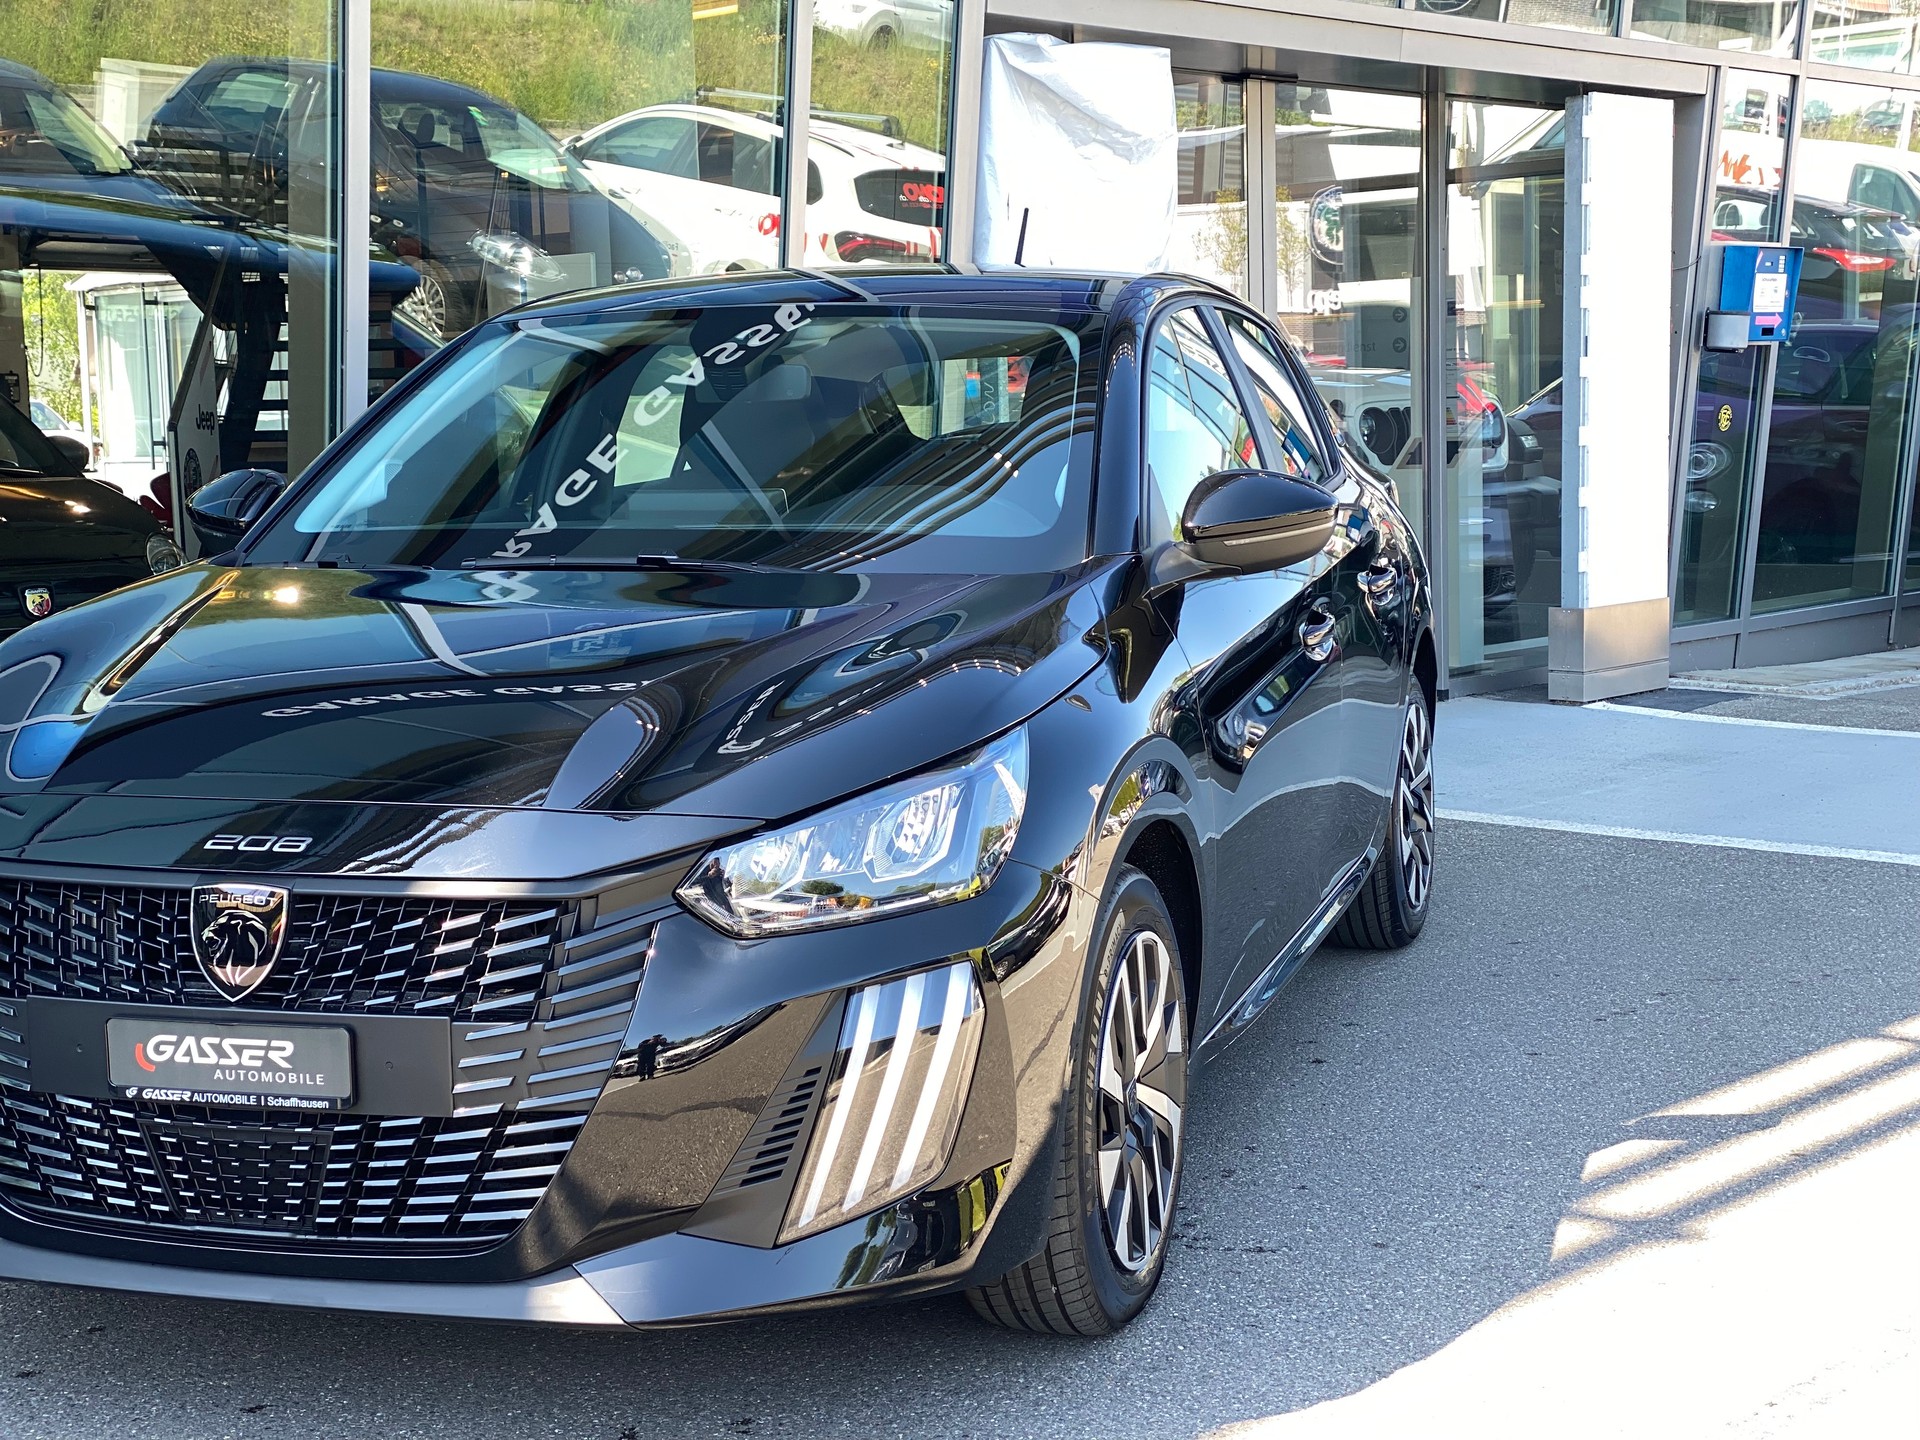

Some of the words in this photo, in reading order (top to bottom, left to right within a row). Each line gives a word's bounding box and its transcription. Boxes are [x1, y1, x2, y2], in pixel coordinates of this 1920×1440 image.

[195, 403, 216, 436] Jeep
[203, 834, 313, 853] 208
[199, 892, 278, 907] PEUGEOT
[146, 1034, 295, 1069] GASSER
[213, 1068, 325, 1086] AUTOMOBILE
[1084, 990, 1105, 1156] MICHELIN
[142, 1088, 191, 1102] GASSER
[192, 1092, 257, 1106] AUTOMOBILE
[267, 1096, 329, 1109] Schaffhausen
